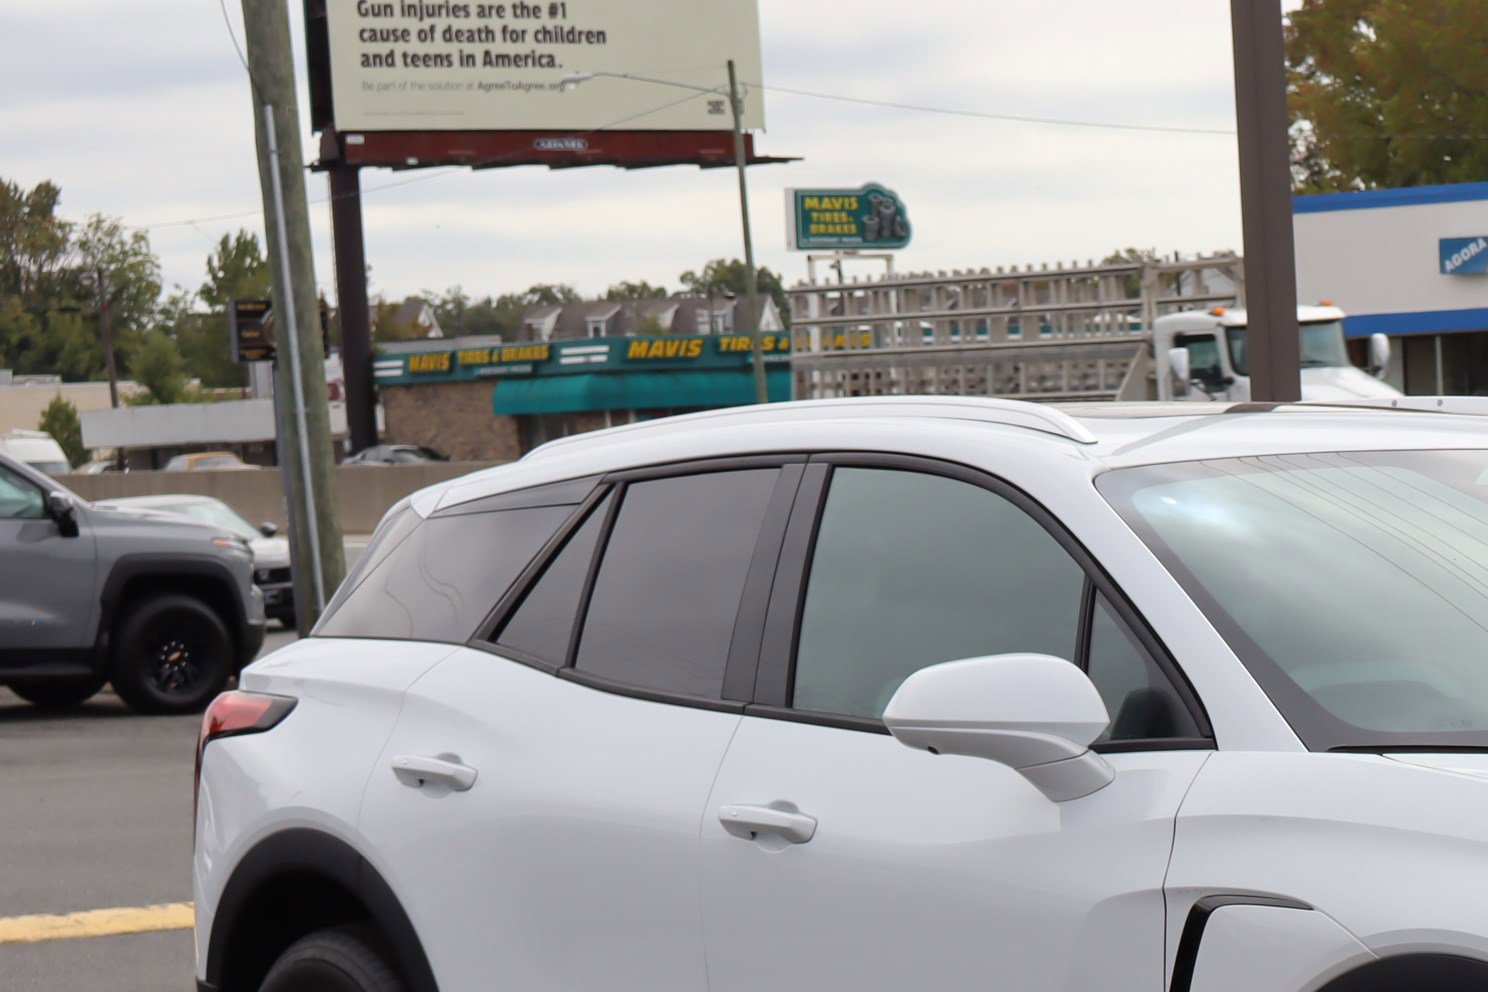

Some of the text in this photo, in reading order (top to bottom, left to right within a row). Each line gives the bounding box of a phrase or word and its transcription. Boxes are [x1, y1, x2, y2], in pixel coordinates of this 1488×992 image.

[357, 0, 568, 22] Gun injuries are the #1
[359, 24, 607, 44] cause of death for children
[360, 50, 563, 68] and teens in America.
[804, 196, 858, 210] MAVIS
[810, 211, 848, 223] TIRES
[809, 223, 857, 234] BRAKES
[1444, 238, 1488, 272] AGORA
[627, 339, 704, 360] MAVIS
[720, 335, 776, 352] TIRS
[408, 352, 450, 373] MAVIS
[501, 344, 549, 363] BRAKES
